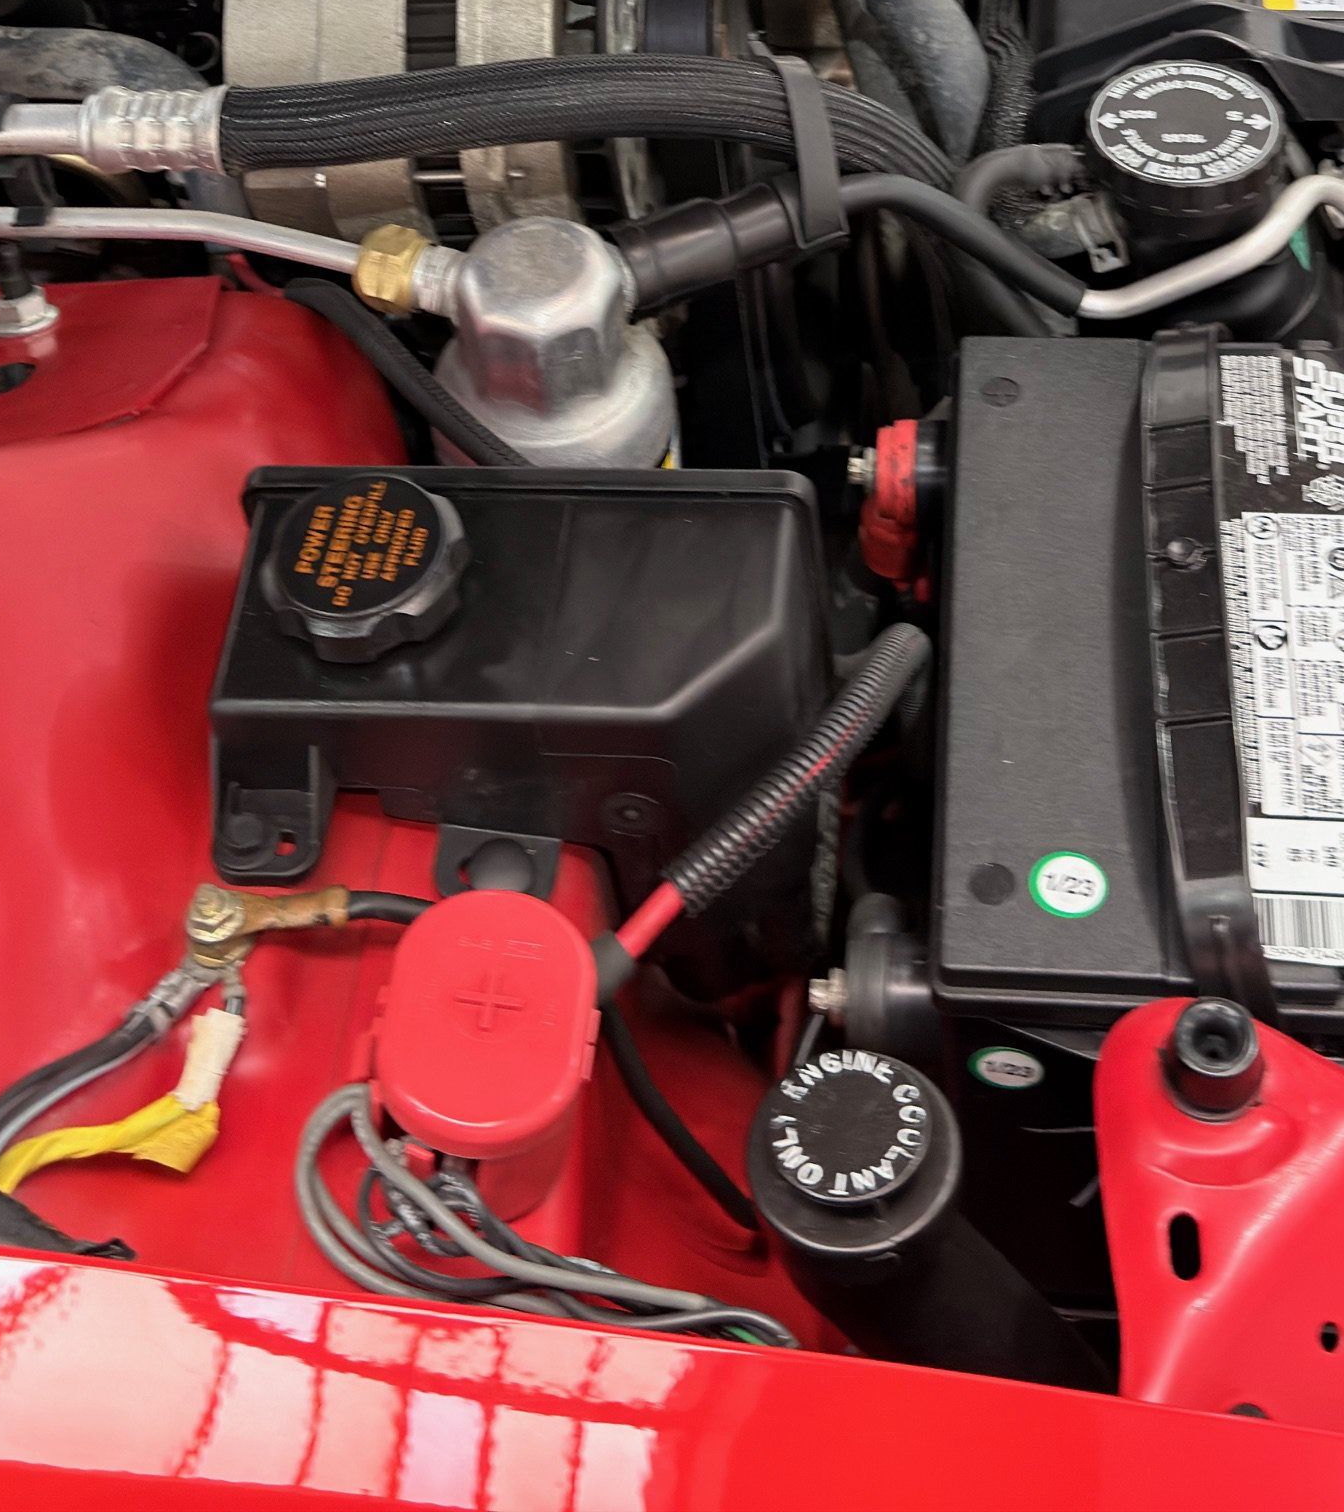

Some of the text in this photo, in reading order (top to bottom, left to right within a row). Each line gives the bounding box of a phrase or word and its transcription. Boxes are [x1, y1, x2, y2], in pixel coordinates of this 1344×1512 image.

[1143, 161, 1201, 179] OPEN
[1202, 143, 1262, 177] NEVER
[1292, 354, 1331, 460] START
[294, 505, 336, 574] POWER
[316, 495, 365, 588] STEERING
[341, 552, 363, 580] NOT
[331, 586, 353, 606] DO
[770, 1049, 927, 1196] ENGINE COOLANT ONLY
